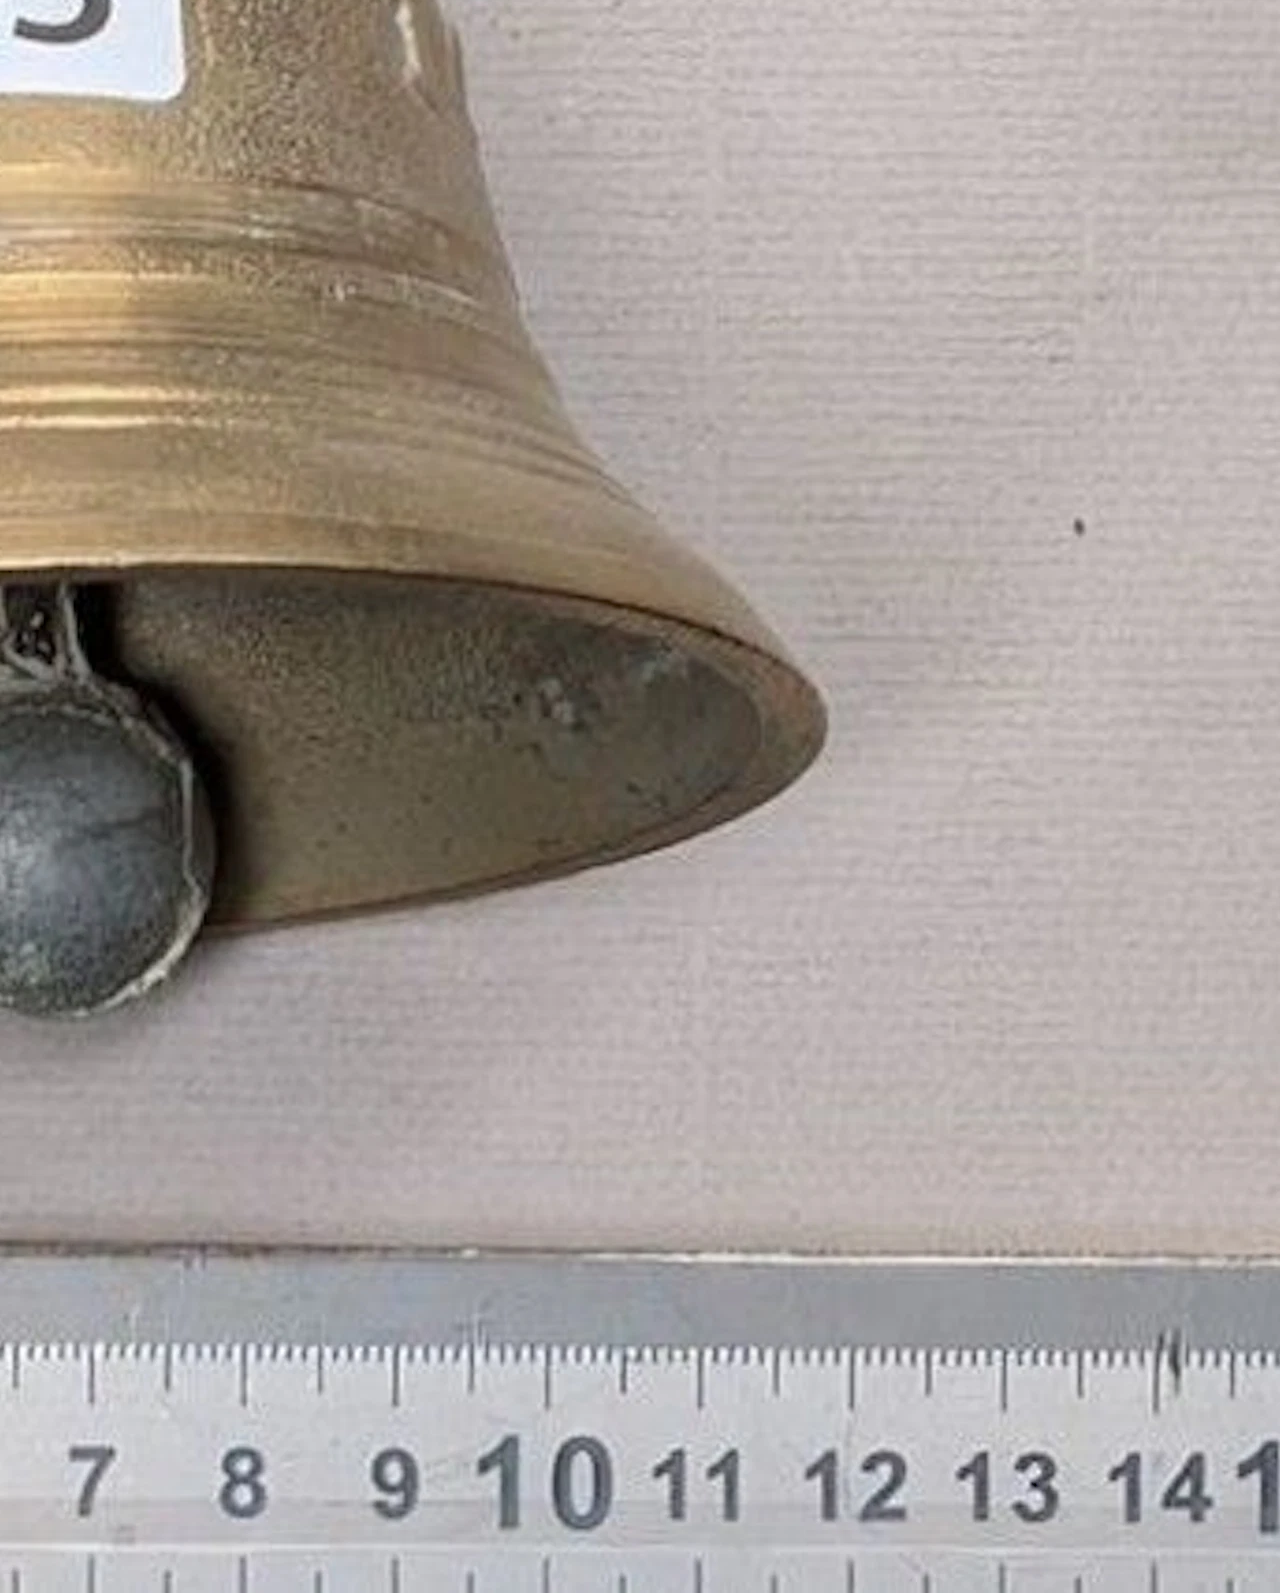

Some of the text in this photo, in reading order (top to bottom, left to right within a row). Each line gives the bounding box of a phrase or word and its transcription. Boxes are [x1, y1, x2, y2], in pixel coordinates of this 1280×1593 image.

[67, 1444, 118, 1520] 7
[217, 1445, 269, 1521] 8
[369, 1446, 421, 1522] 9
[475, 1433, 614, 1533] 10
[651, 1446, 741, 1524] 11
[803, 1447, 909, 1525] 12
[954, 1449, 1061, 1525] 13
[1106, 1450, 1215, 1526] 14
